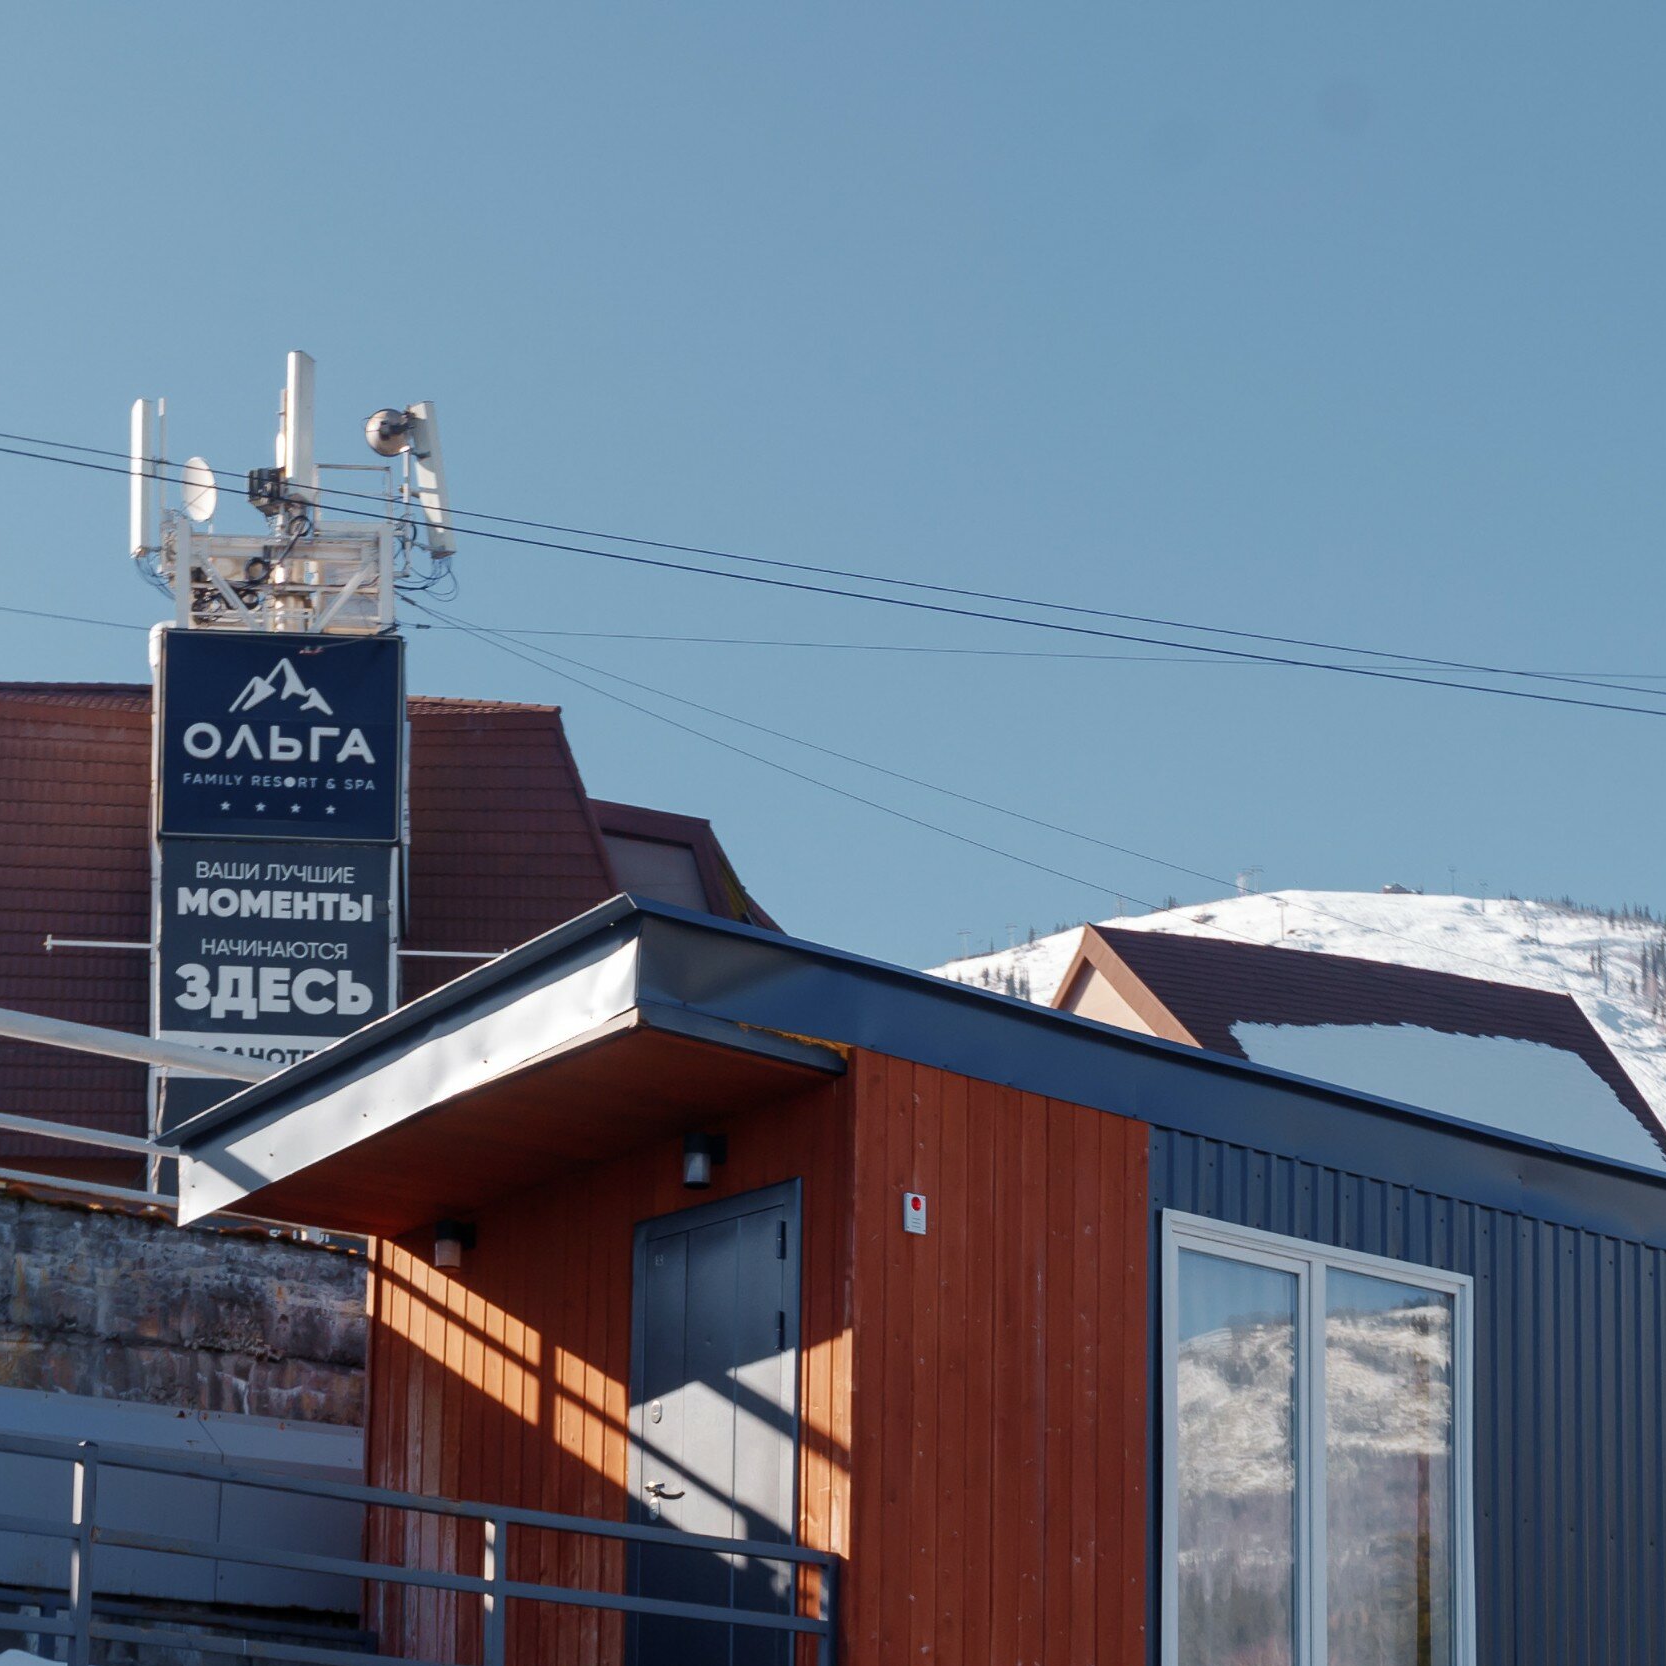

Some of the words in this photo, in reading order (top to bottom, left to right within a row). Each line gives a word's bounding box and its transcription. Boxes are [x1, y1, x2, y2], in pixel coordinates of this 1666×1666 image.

[183, 722, 376, 765] ОЛЬГА
[183, 772, 244, 787] FAMILY
[326, 778, 336, 790] &
[344, 778, 376, 791] SPA
[195, 860, 260, 880] ВАШИ
[264, 863, 356, 884] ЛУЧШИЕ
[177, 886, 374, 922] МОМЕНТЫ
[200, 938, 348, 960] НАЧИНАЮТСЯ
[174, 962, 374, 1020] ЗДЕСЬ
